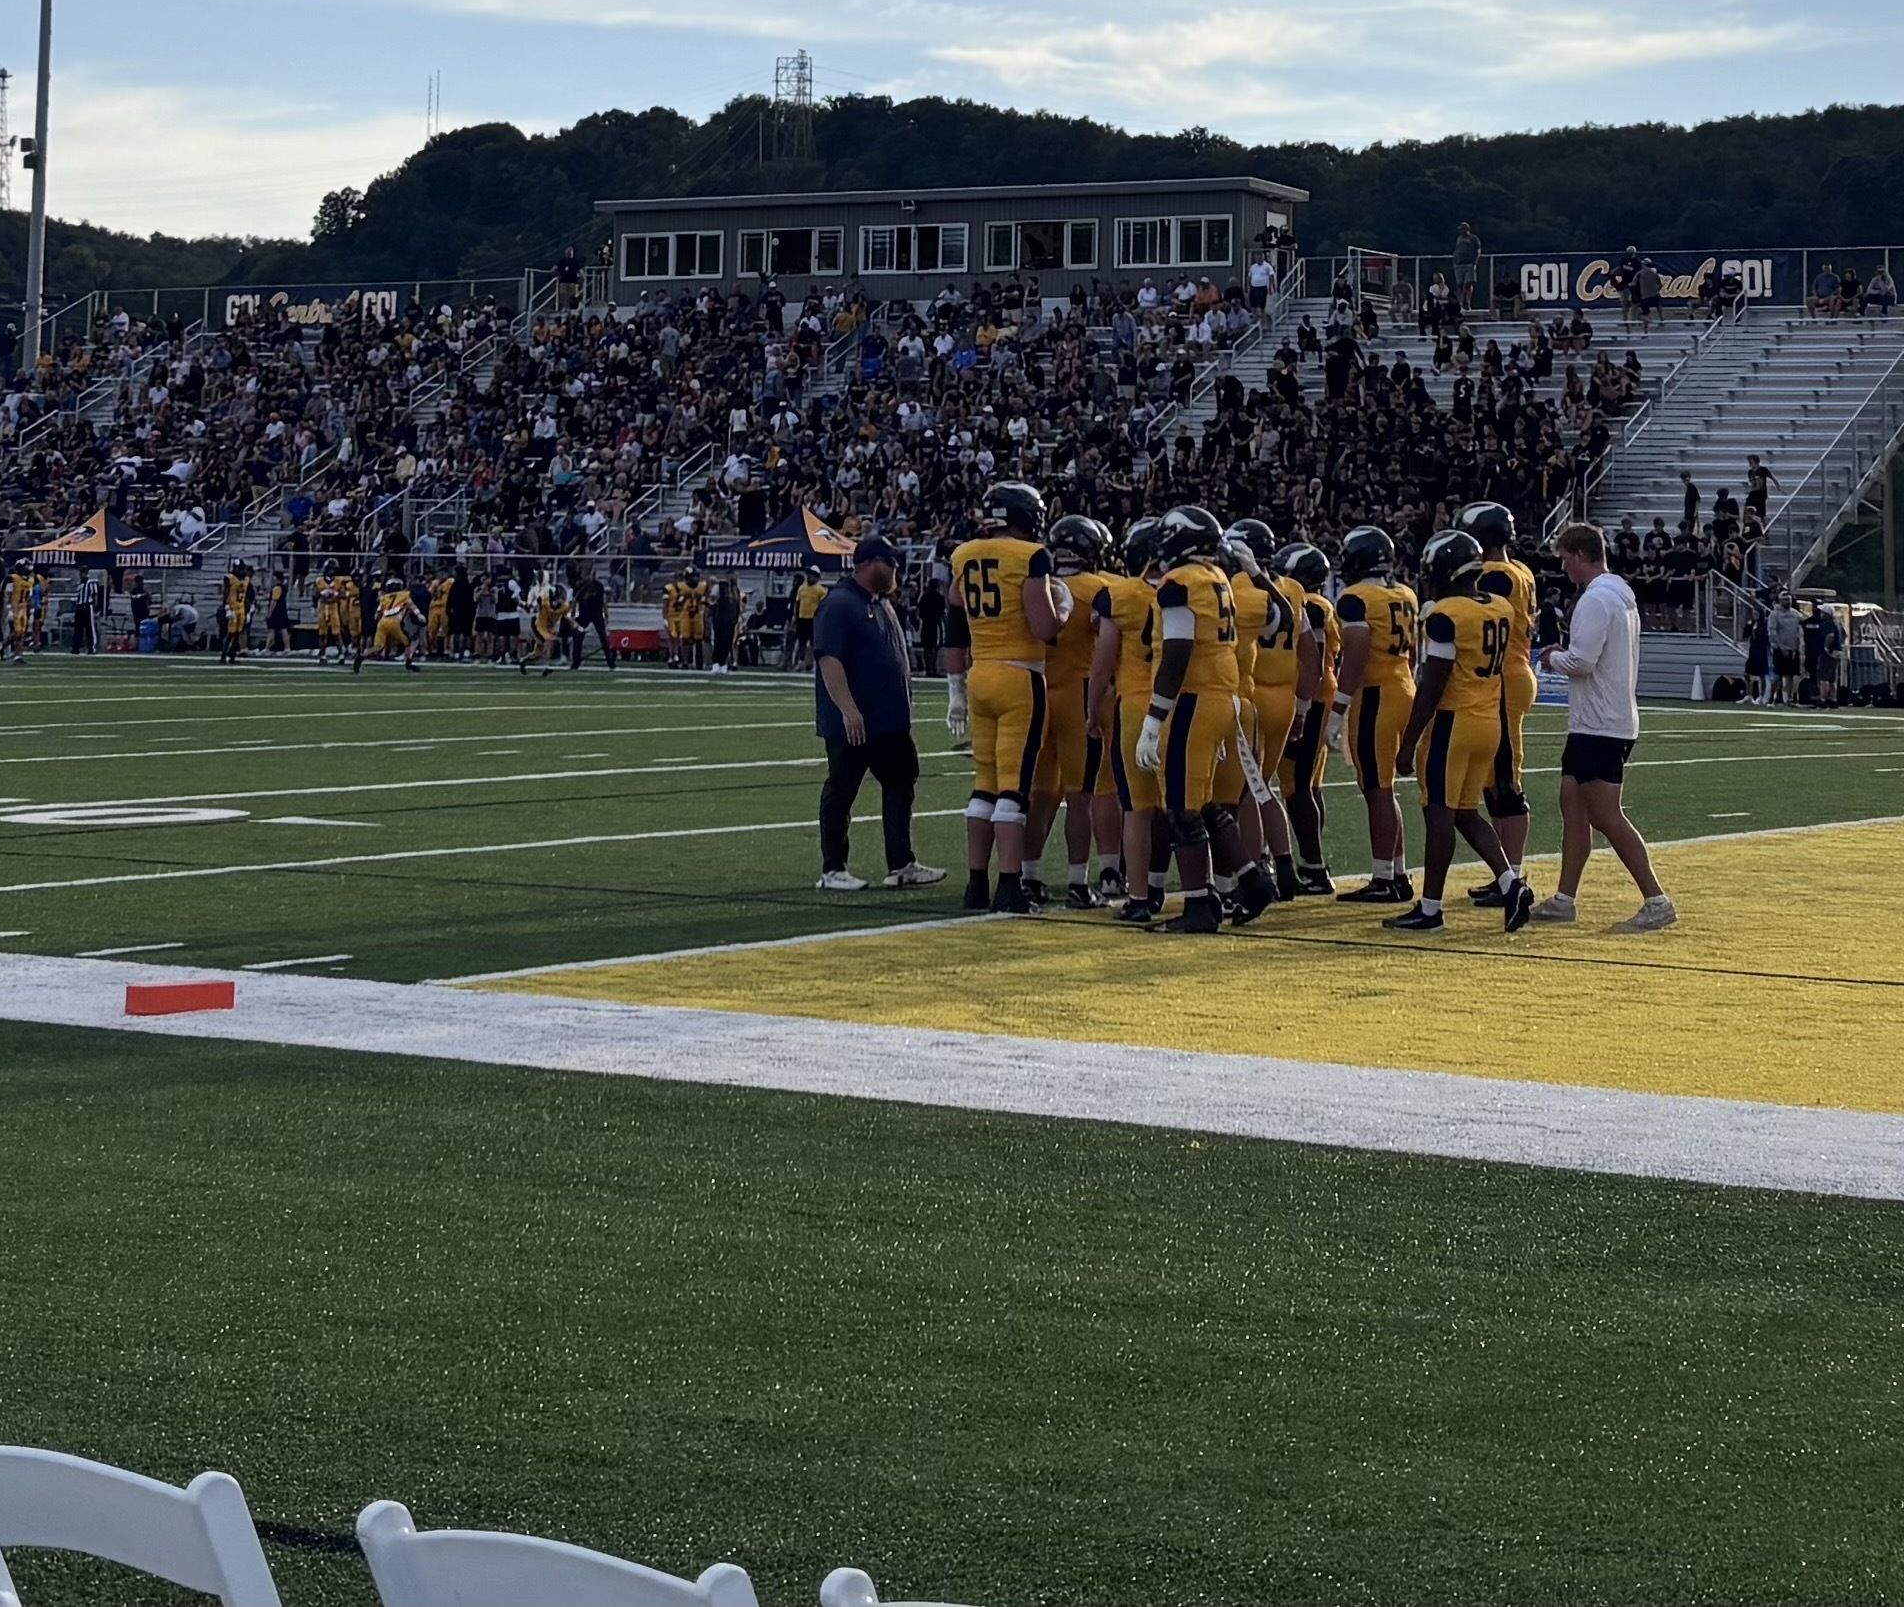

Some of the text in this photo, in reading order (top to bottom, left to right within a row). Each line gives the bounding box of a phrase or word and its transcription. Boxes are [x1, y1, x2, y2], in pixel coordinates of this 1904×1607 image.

[1519, 262, 1570, 302] GO!
[114, 552, 192, 568] CENTRAL CATHOLIC
[705, 551, 802, 568] CENTRAL CATHOLIC
[963, 558, 1004, 619] 65
